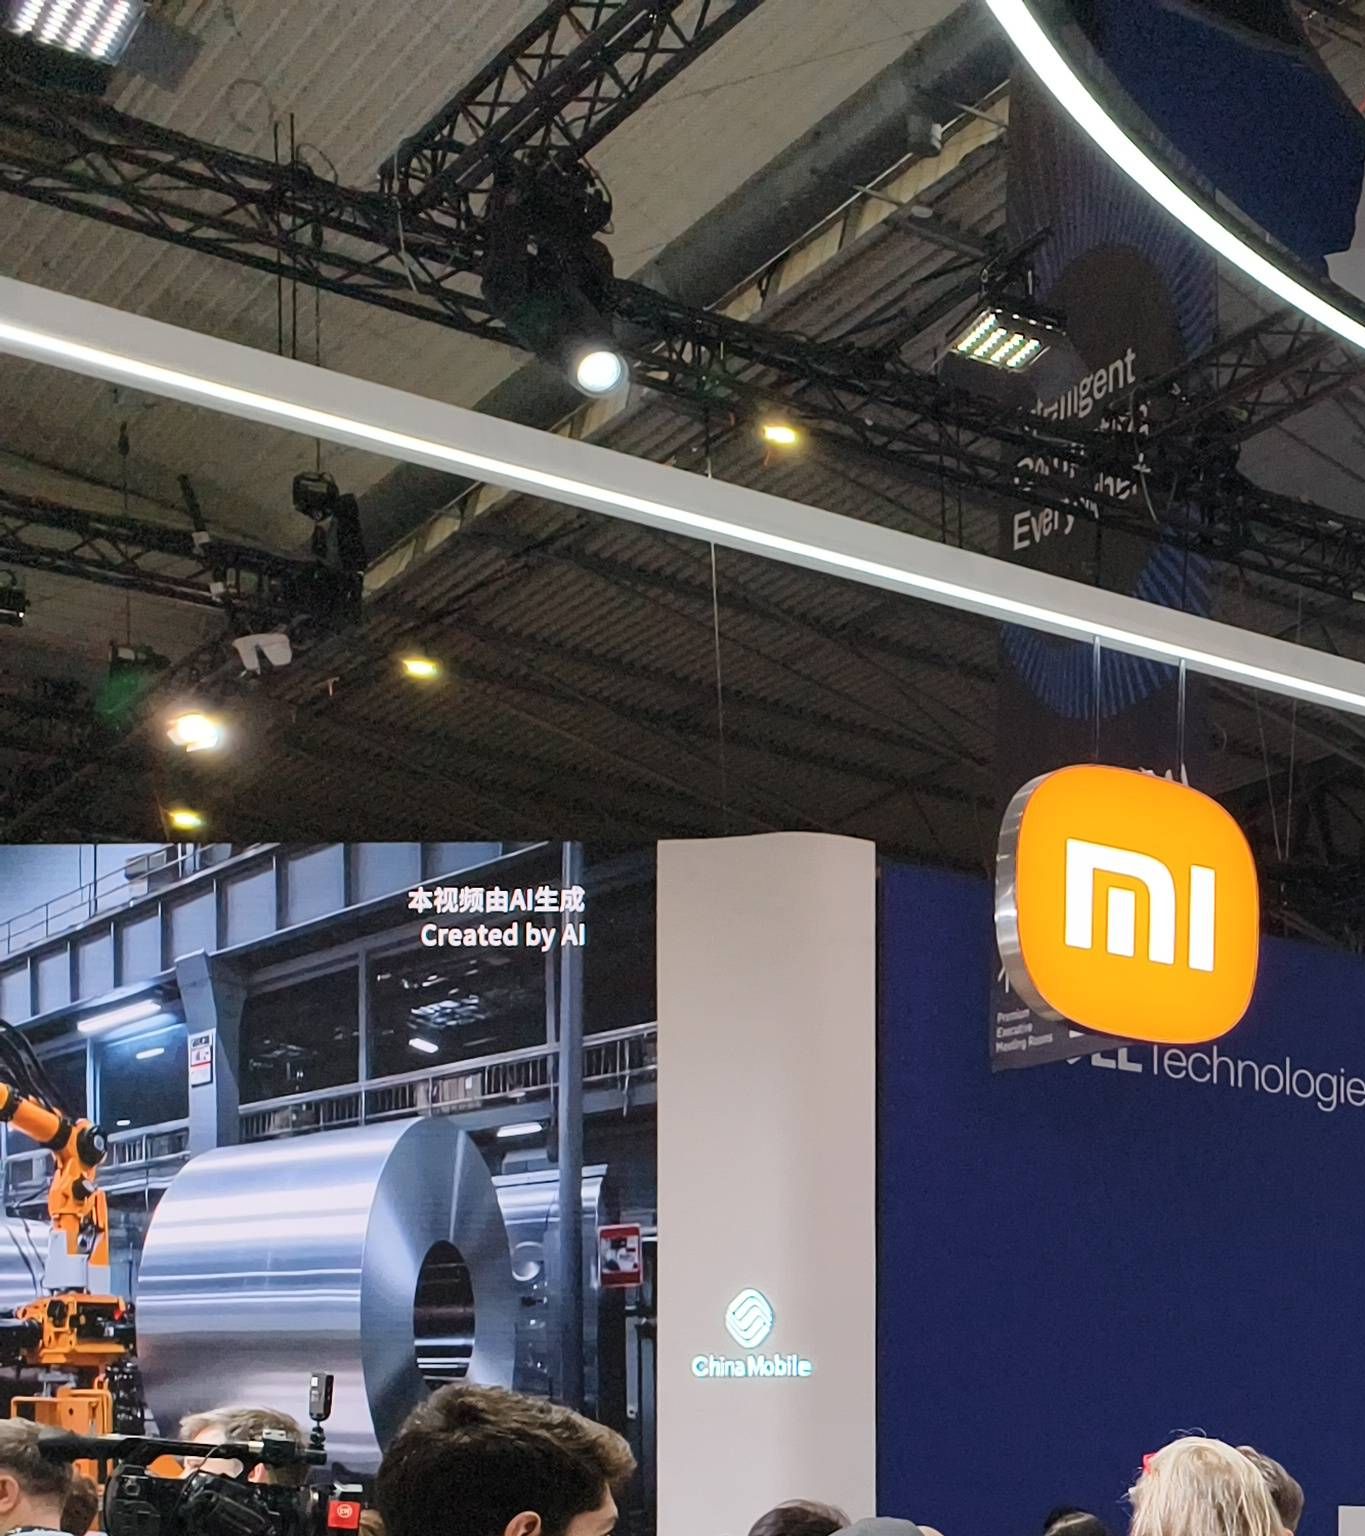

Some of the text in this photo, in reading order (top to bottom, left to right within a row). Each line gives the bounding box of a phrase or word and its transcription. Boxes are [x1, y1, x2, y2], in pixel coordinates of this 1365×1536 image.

[408, 886, 586, 914] 本视频由AI生成
[421, 922, 586, 952] Created by AI
[691, 1353, 812, 1377] China Mobile
